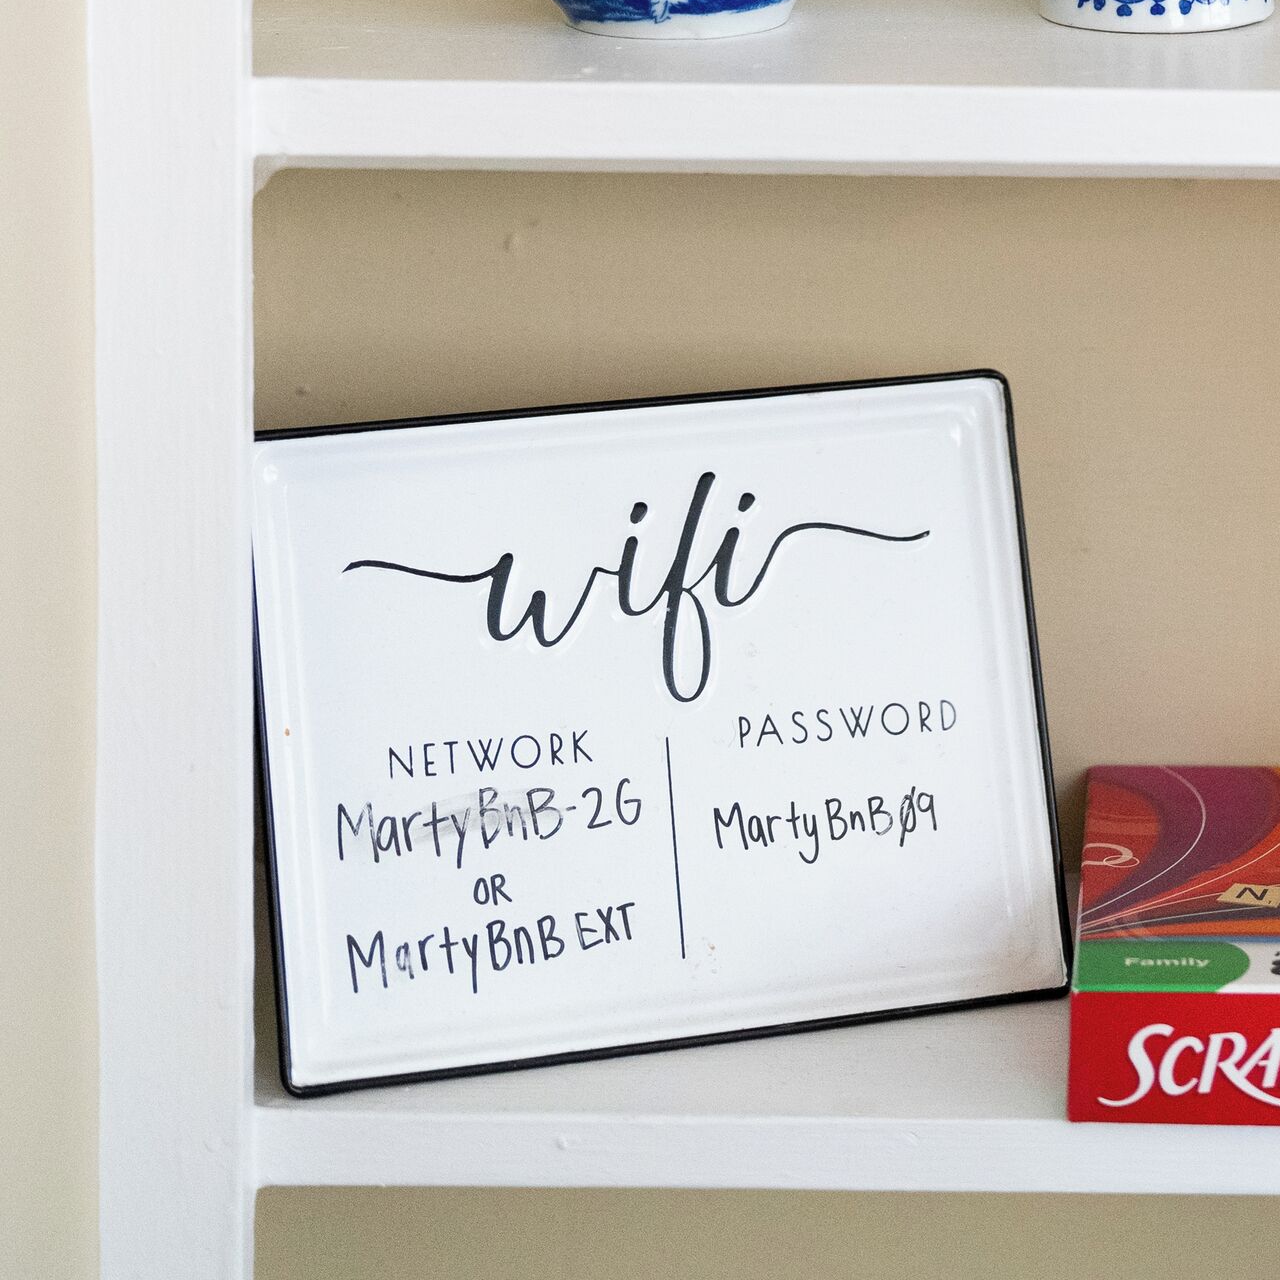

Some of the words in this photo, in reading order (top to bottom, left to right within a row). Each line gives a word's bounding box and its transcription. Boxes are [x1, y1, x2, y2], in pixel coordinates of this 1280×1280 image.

[342, 472, 931, 703] wifi
[737, 698, 958, 749] PASSWORD
[388, 729, 593, 779] NETWORK
[473, 873, 513, 906] OR
[1235, 887, 1269, 901] N
[577, 902, 636, 952] EXT
[1124, 955, 1210, 969] Family
